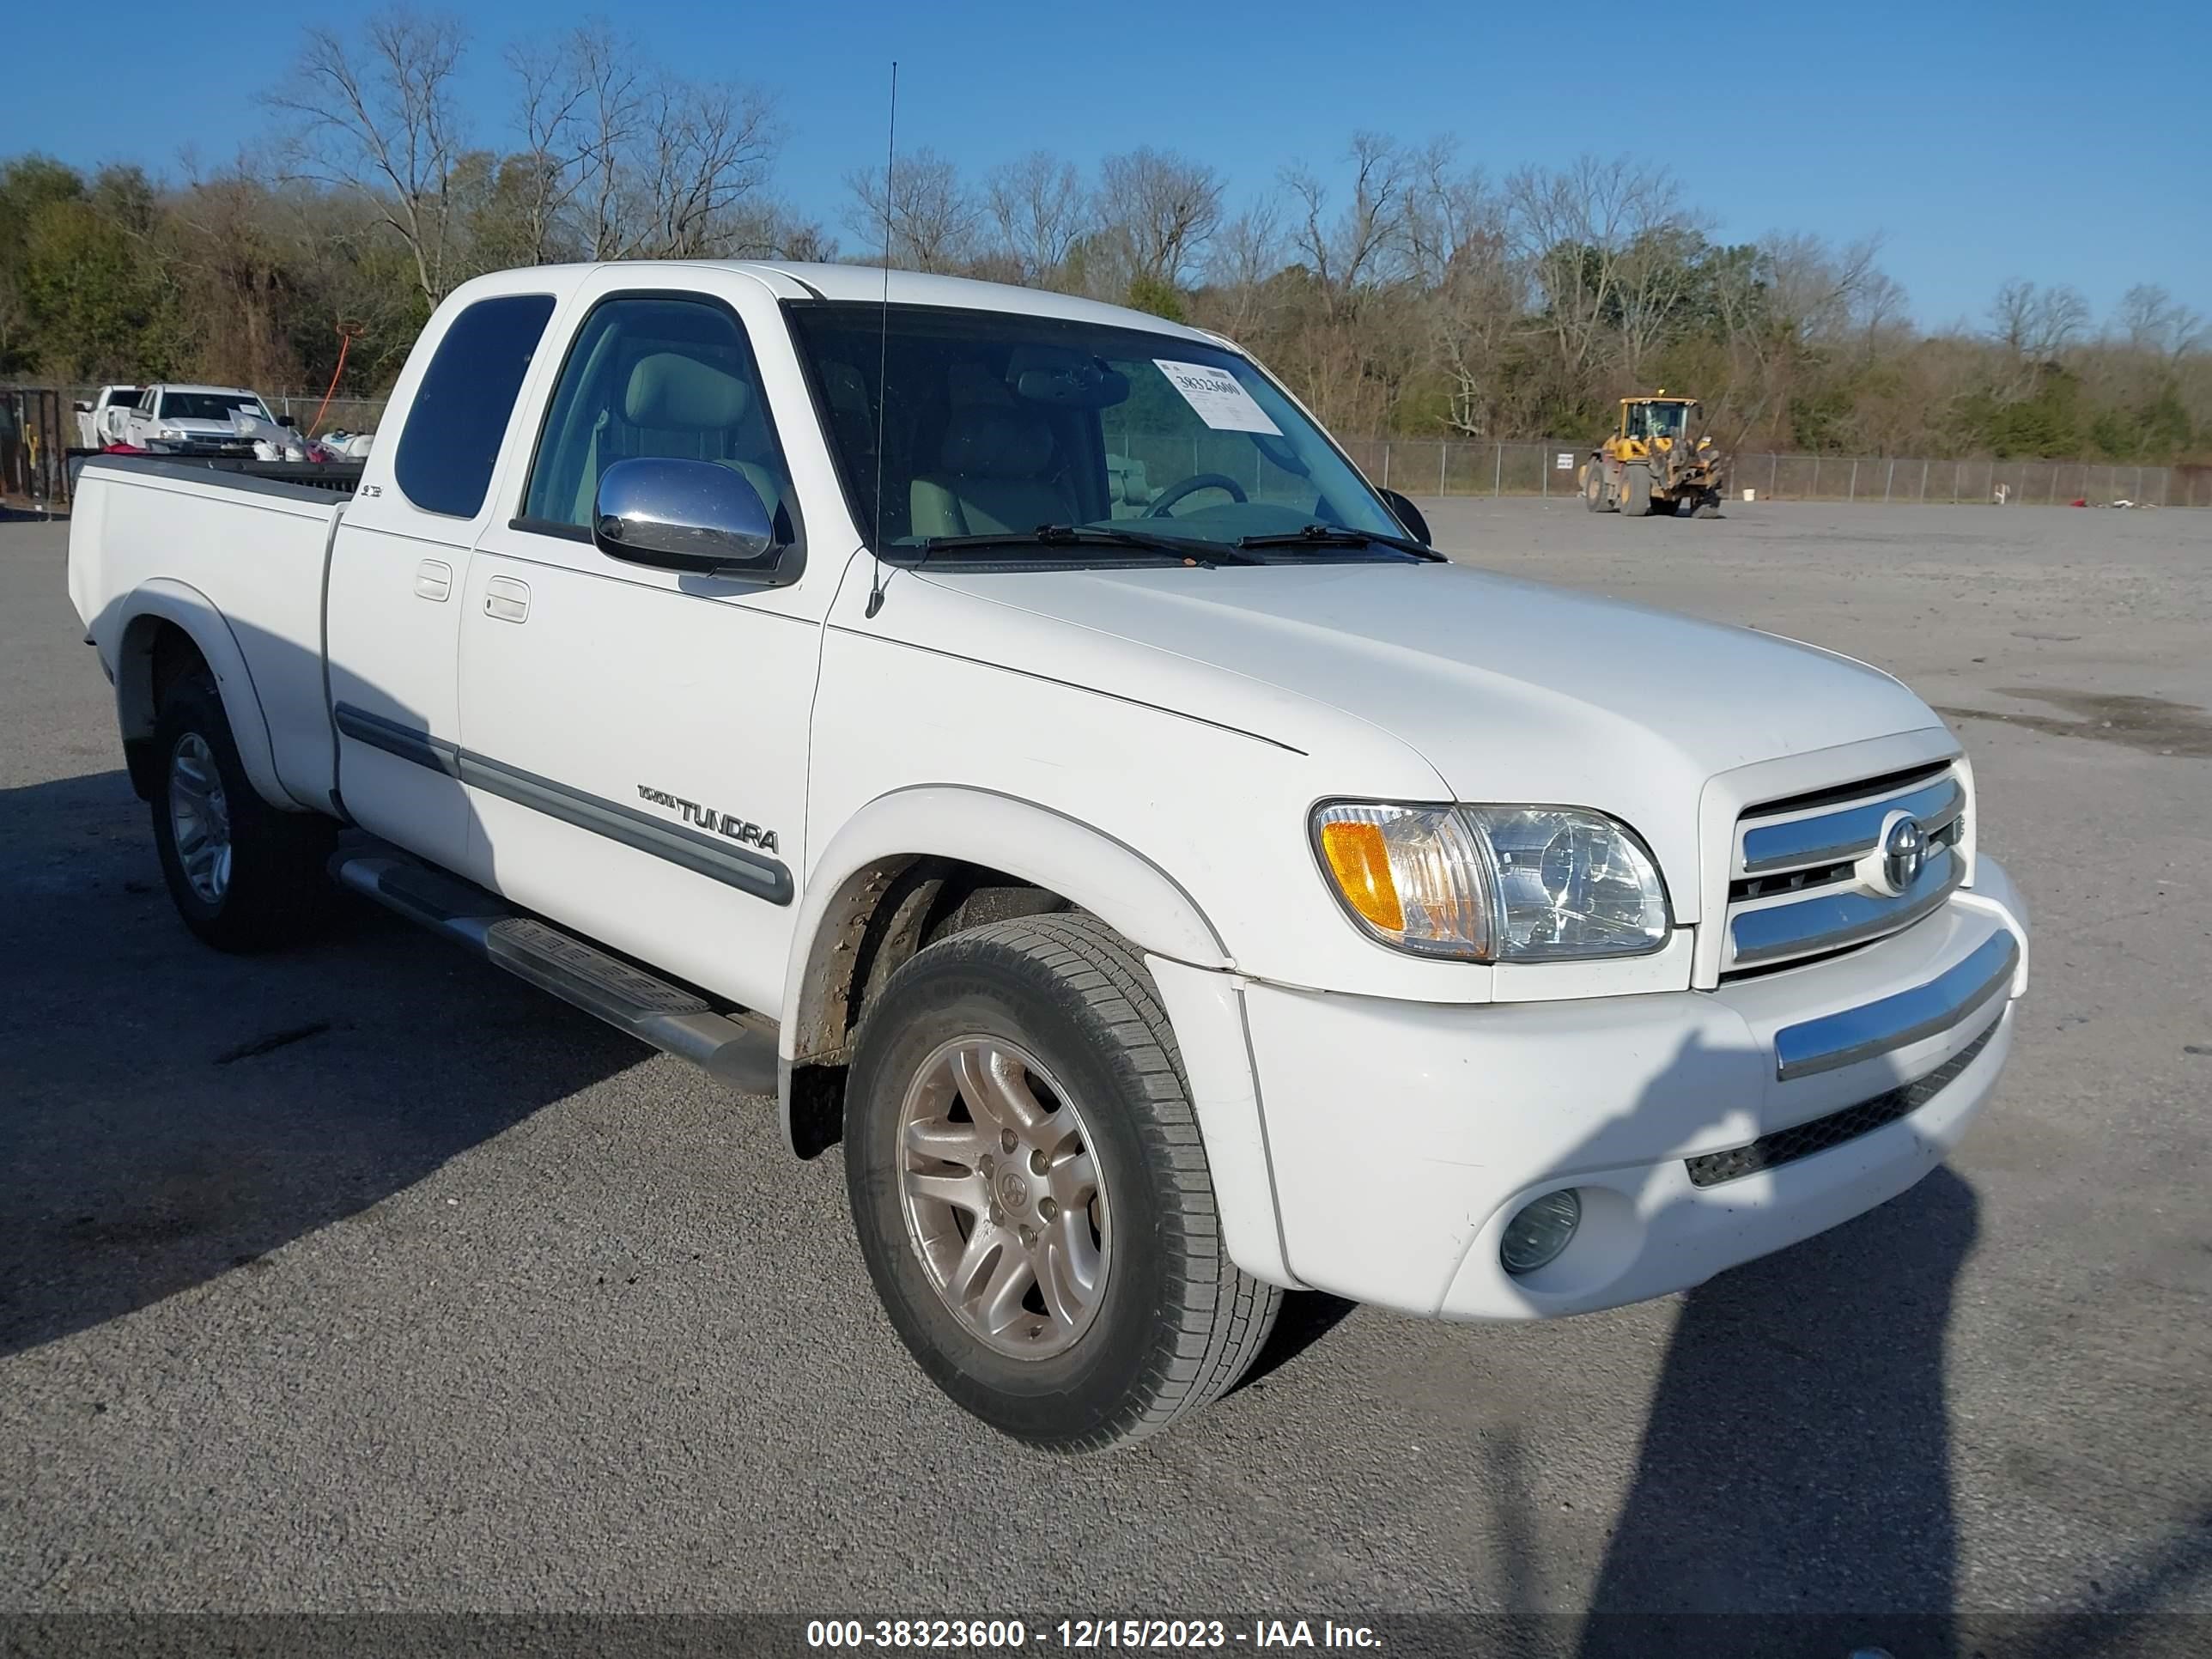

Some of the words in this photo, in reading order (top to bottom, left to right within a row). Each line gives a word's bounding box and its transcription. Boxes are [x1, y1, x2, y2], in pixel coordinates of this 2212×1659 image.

[1176, 376, 1241, 395] 38323600
[637, 784, 680, 811] TOYOTA
[678, 799, 779, 854] TUNDRA
